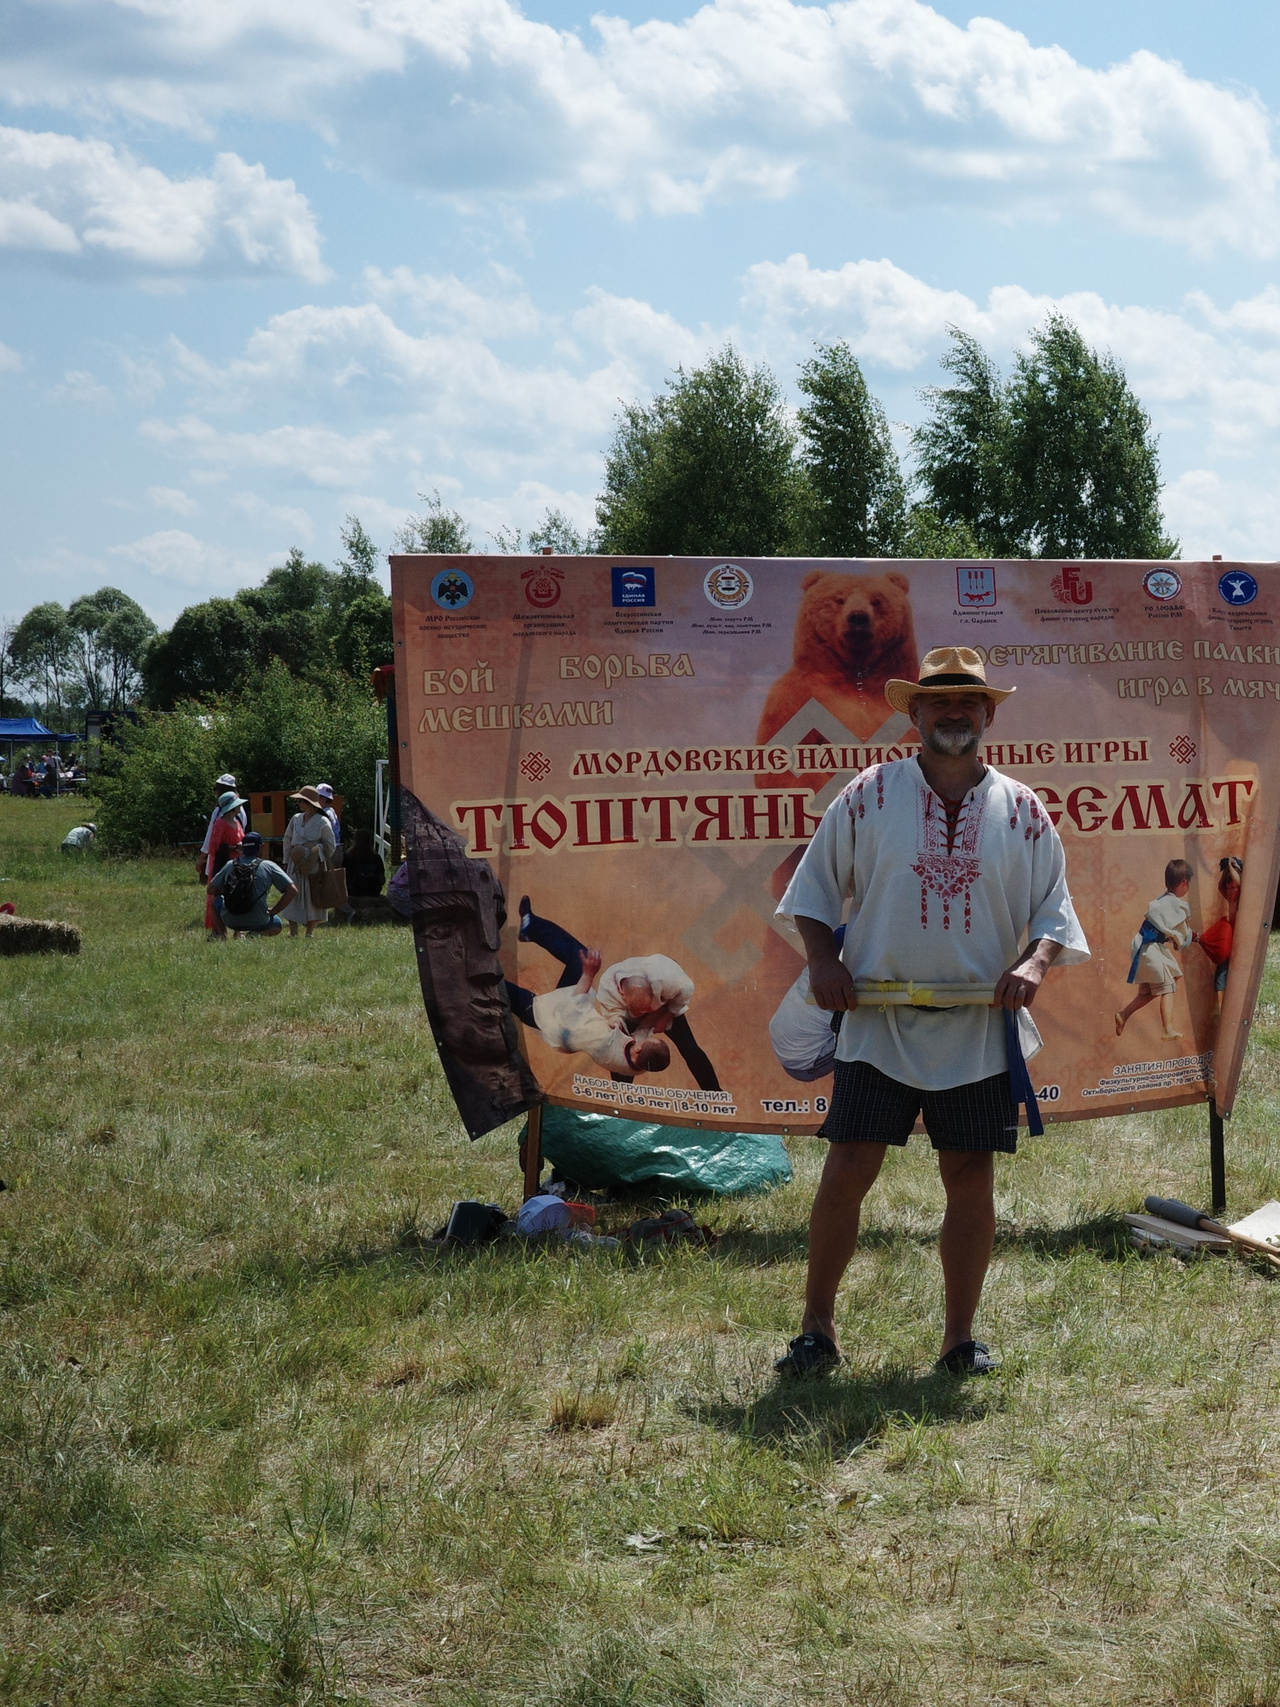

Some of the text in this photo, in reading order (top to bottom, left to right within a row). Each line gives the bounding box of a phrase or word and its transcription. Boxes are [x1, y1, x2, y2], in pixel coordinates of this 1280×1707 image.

[952, 609, 1003, 617] Администрация
[573, 748, 788, 777] МОРДОВСКИЕ
[1063, 740, 1149, 763] ИГРЫ
[1114, 1061, 1162, 1076] ЗАНЯТИЯ
[574, 1074, 732, 1102] НАБОР В ГРУППЫ ОБУЧЕНИЯ:
[1137, 1081, 1161, 1091] района
[573, 1086, 592, 1097] 3-6
[595, 1092, 616, 1101] лет
[626, 1096, 646, 1106] 6-8
[649, 1100, 671, 1109] лет
[681, 1102, 709, 1113] 8-10
[712, 1106, 736, 1115] лет
[762, 1097, 827, 1112] тел.: 8
